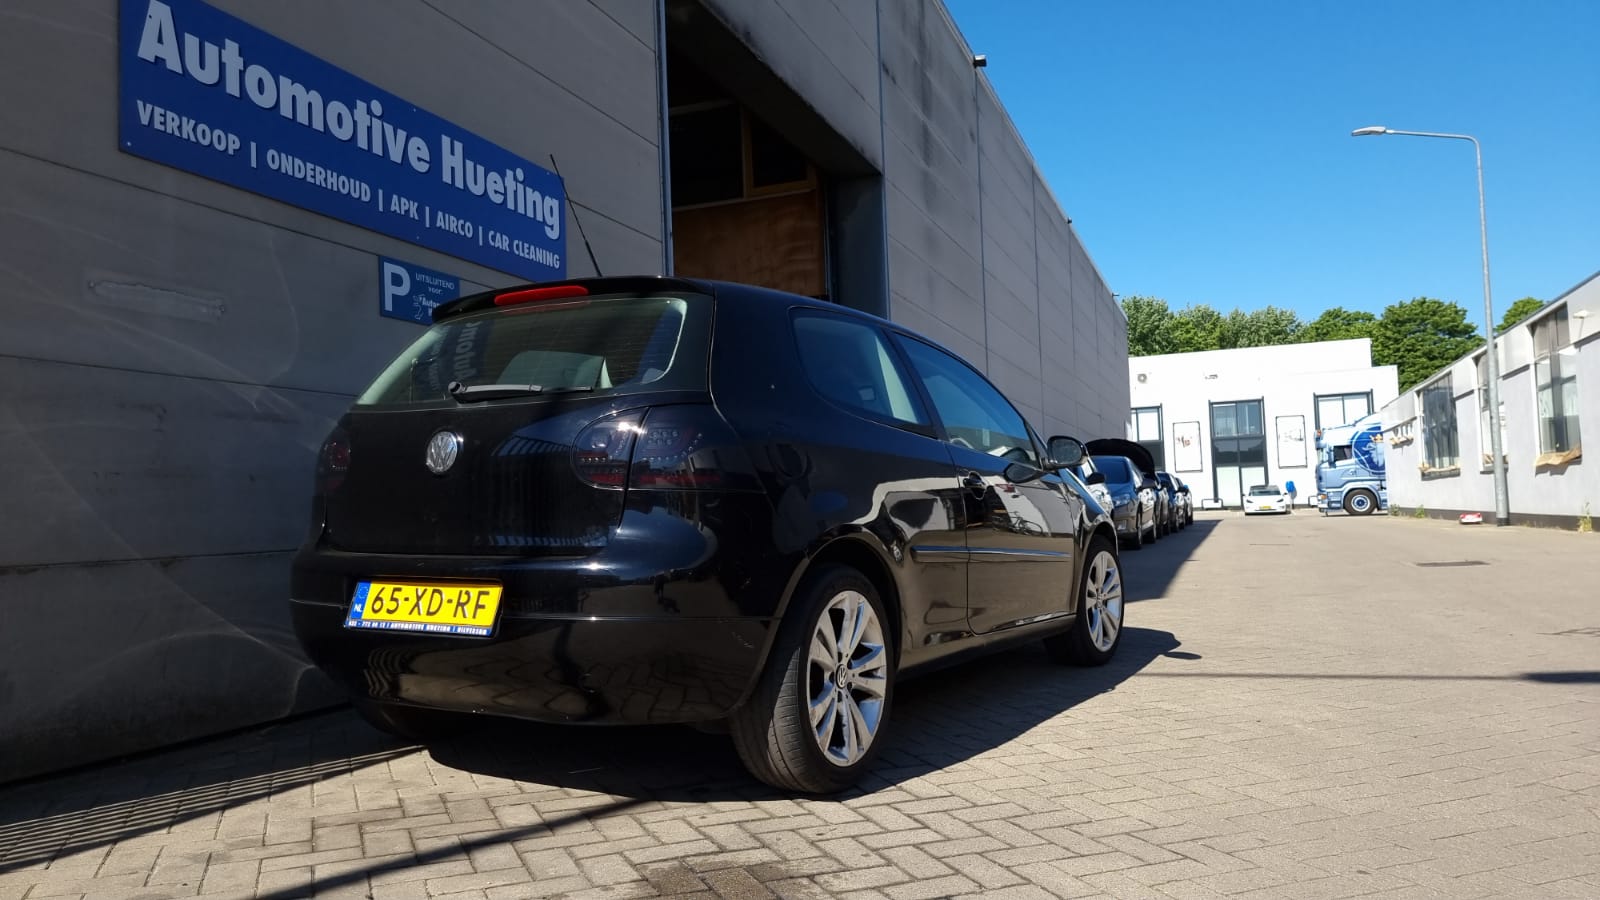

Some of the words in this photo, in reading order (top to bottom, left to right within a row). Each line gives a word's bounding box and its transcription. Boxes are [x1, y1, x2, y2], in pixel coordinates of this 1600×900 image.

[137, 0, 431, 173] Automotive
[441, 134, 560, 241] Hueting
[137, 100, 240, 156] VERKOOP
[267, 149, 371, 202] ONDERHOUD
[390, 195, 419, 220] APK
[436, 211, 474, 239] AIRCO
[488, 230, 510, 252] CAR
[513, 239, 561, 269] CLEANING
[383, 261, 411, 312] P
[415, 272, 455, 290] UITSLUITEND
[354, 603, 362, 613] NL
[371, 586, 490, 619] 65-XD-RF
